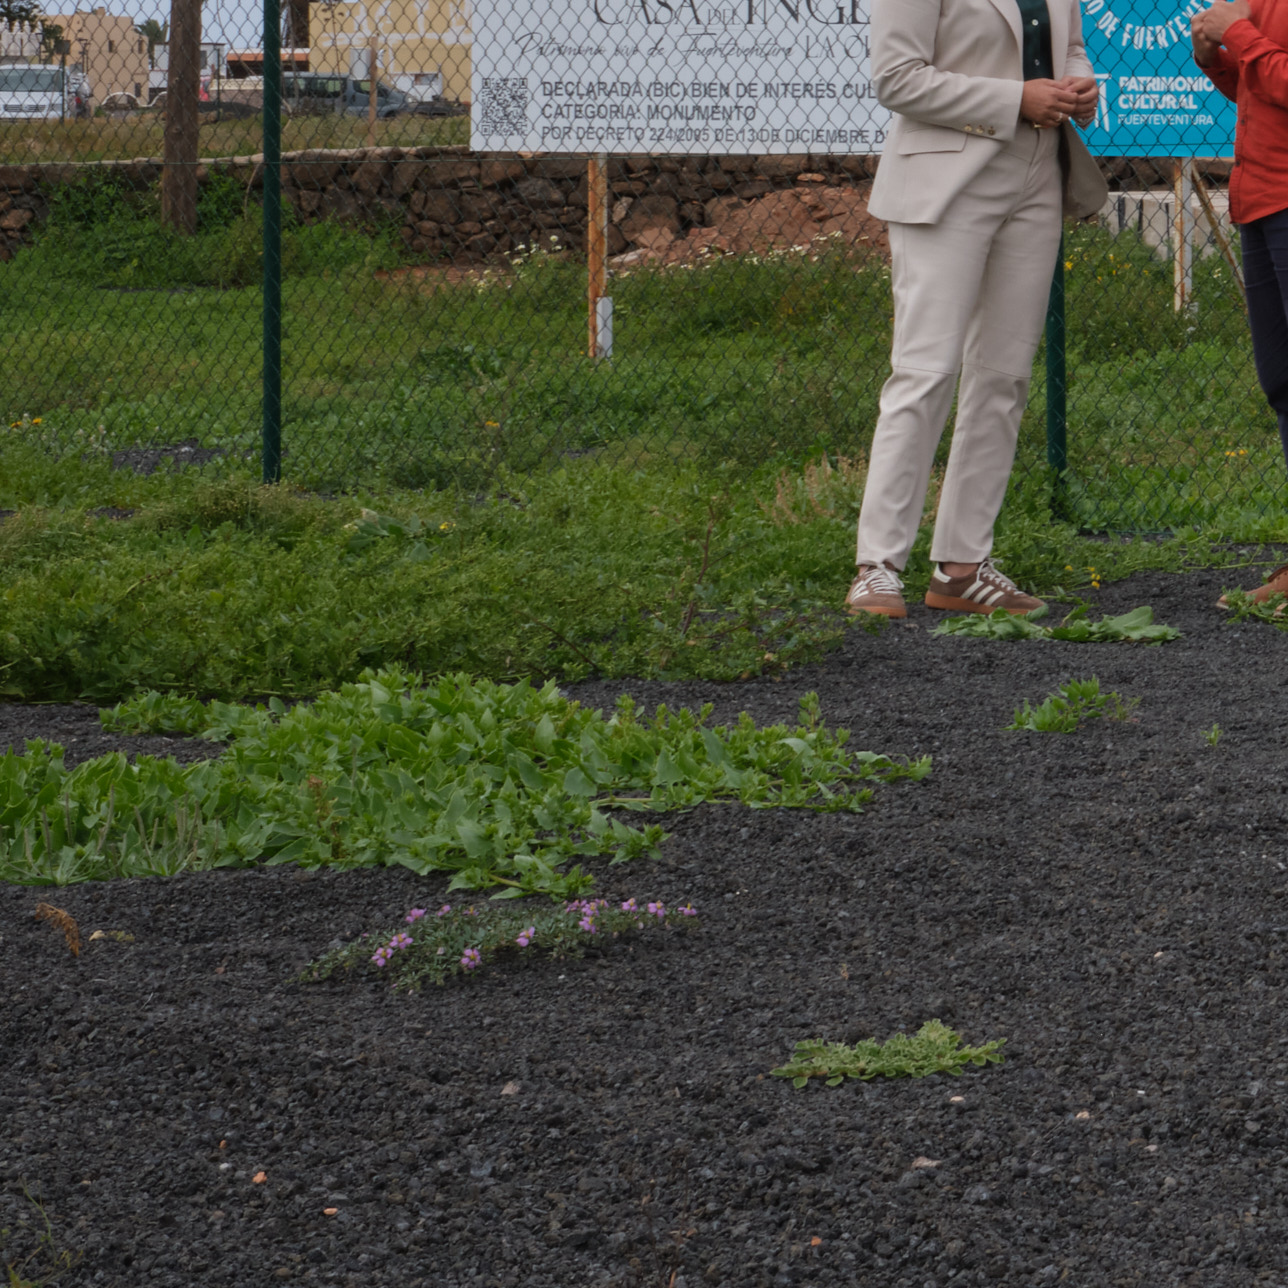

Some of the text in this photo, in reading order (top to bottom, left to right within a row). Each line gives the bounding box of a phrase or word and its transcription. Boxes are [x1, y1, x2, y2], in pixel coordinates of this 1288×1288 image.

[708, 8, 741, 26] DEL
[1096, 10, 1121, 40] DE
[805, 34, 836, 58] LA
[542, 81, 644, 98] DECLARADA
[648, 81, 687, 102] (BIC)
[691, 82, 730, 99] BIEN
[736, 82, 758, 99] DE
[764, 78, 837, 99] INTERÉS
[1118, 75, 1215, 92] PATRIMONIO
[1118, 93, 1198, 110] CULTURAL
[648, 104, 757, 121] MONUMENTO
[1117, 114, 1214, 126] FUERTEVENTURA
[542, 126, 888, 145] POR DECRETO 224/2005 DE 13 DE DICIEMBRE D
